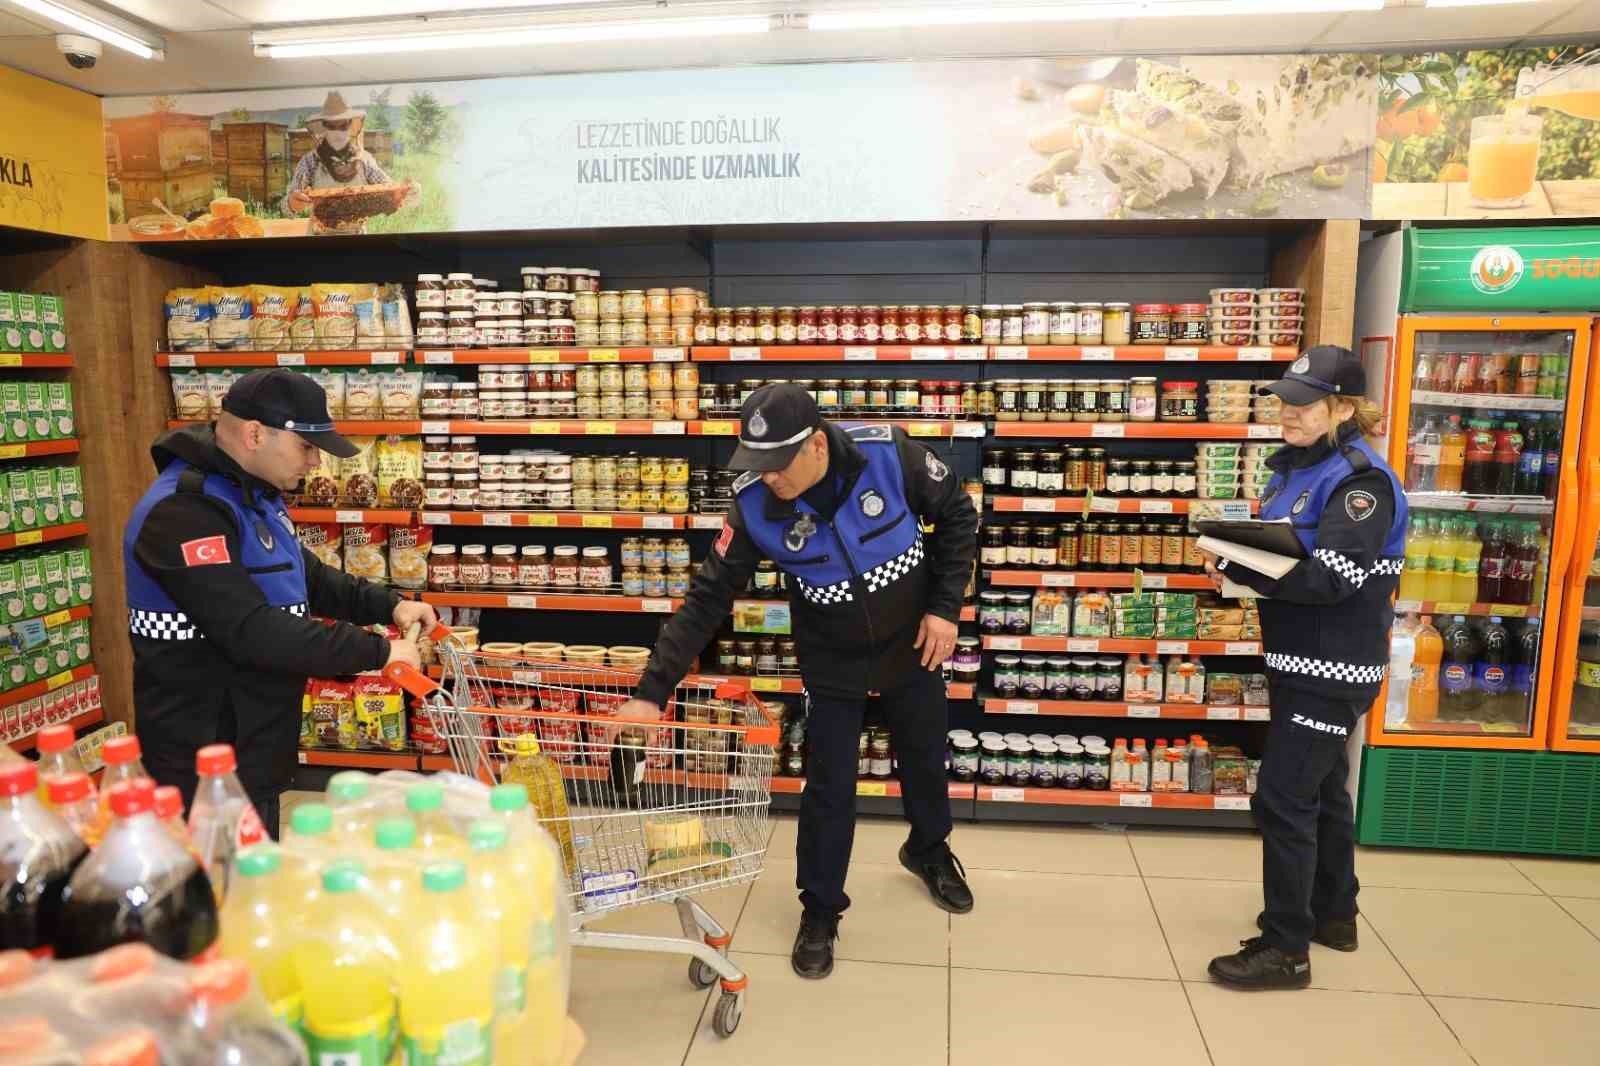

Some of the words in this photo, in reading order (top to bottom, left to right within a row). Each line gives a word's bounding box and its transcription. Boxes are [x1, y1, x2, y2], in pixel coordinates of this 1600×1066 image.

[577, 118, 685, 148] LEZZETİNDE
[690, 115, 782, 145] DOĞALLIK
[577, 152, 697, 184] KALİTESİNDE
[702, 152, 801, 180] UZMANLIK
[1291, 713, 1347, 736] ZABITA
